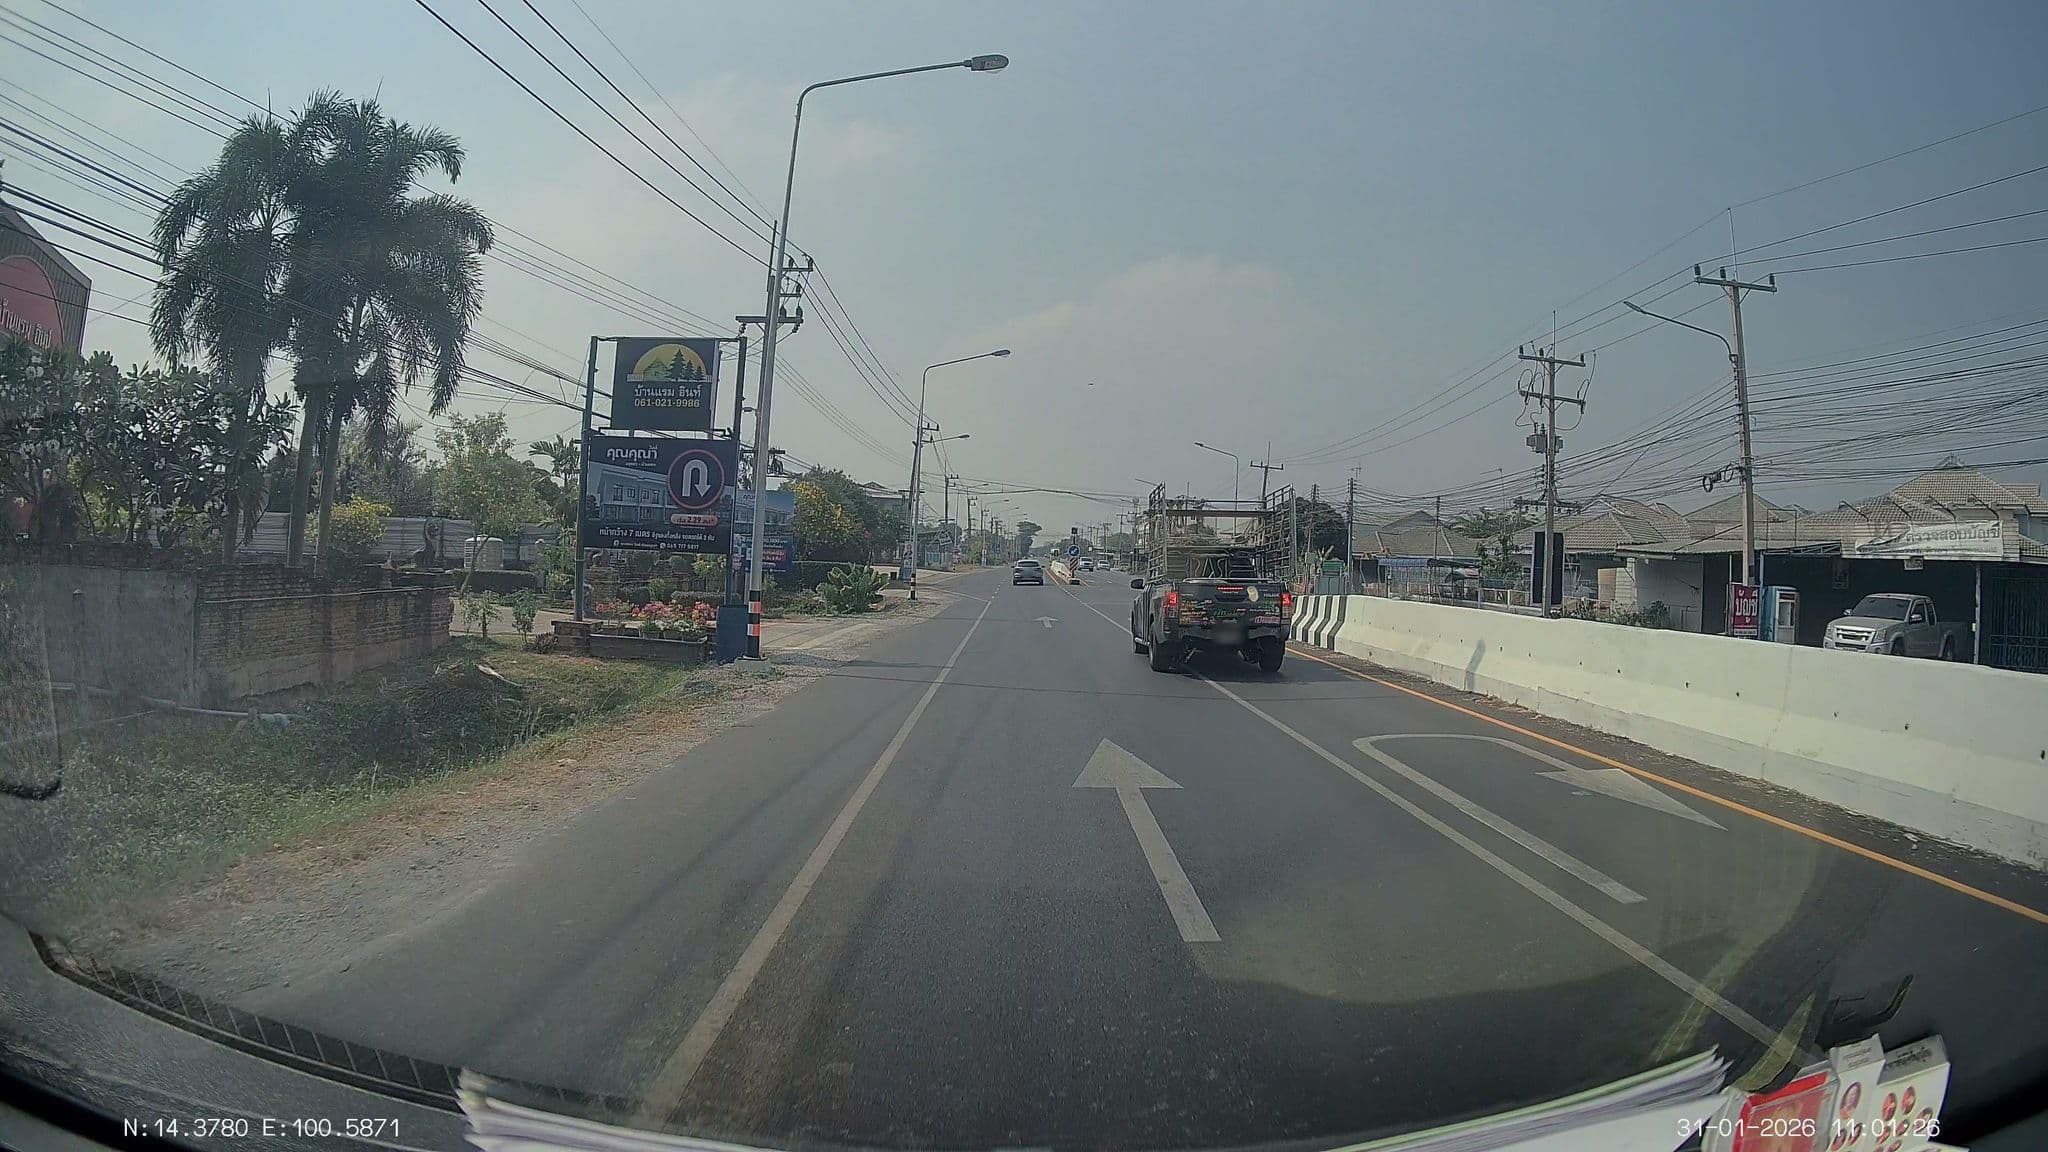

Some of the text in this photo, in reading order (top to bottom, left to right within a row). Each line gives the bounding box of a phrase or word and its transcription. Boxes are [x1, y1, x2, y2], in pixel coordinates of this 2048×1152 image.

[634, 384, 703, 398] บ้านแรม อินท์
[634, 398, 700, 407] 061-021-9986
[629, 529, 634, 537] 7
[1735, 589, 1758, 623] บัญชี
